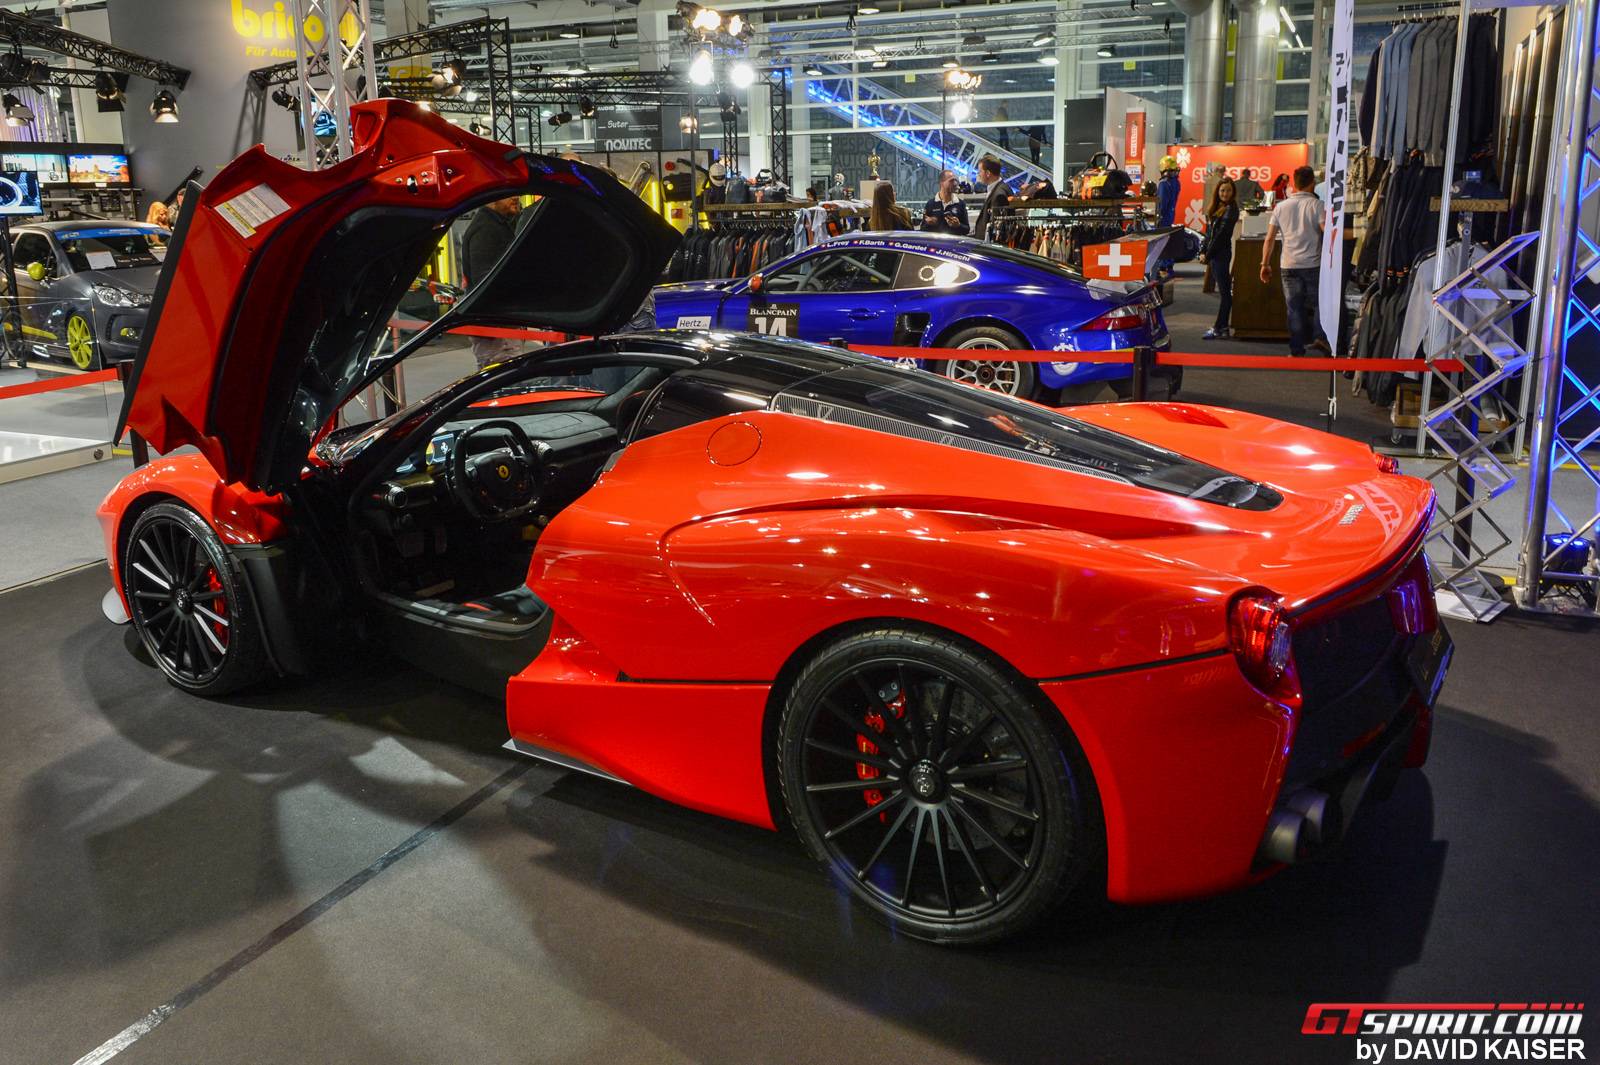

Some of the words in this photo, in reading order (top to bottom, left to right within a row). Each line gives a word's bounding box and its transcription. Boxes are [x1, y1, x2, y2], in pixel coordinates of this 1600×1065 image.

[749, 307, 797, 317] BLANCPAIN
[679, 319, 702, 328] Hertz
[754, 316, 788, 337] 14
